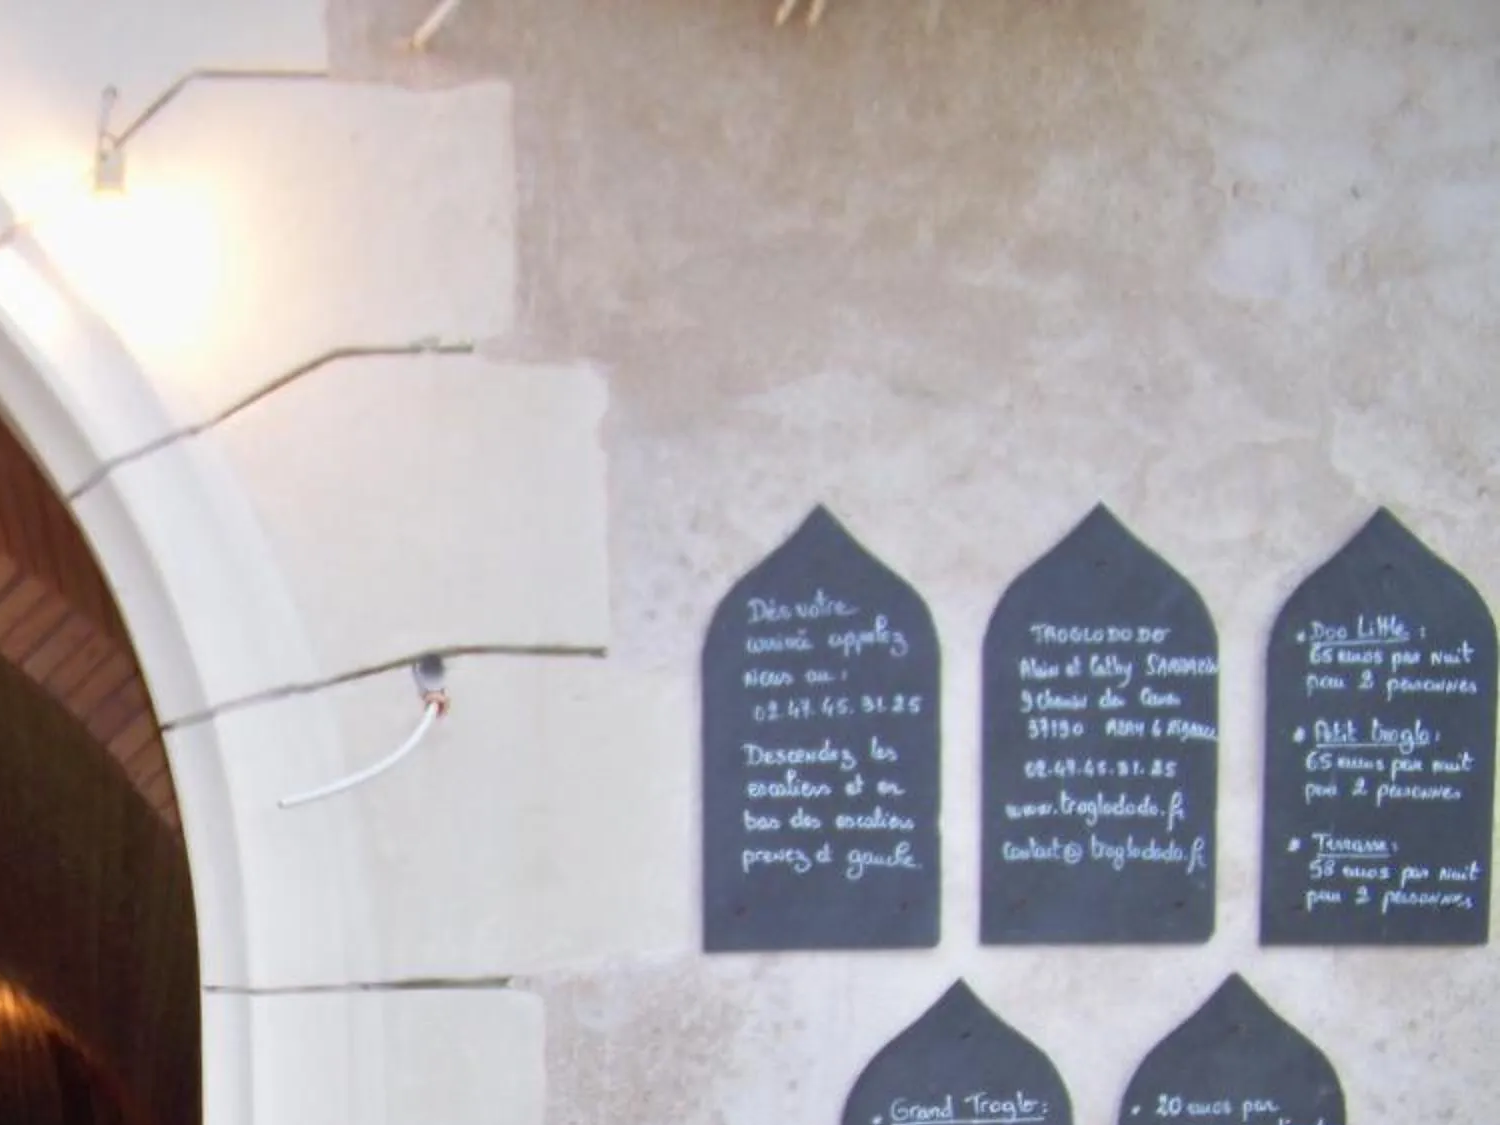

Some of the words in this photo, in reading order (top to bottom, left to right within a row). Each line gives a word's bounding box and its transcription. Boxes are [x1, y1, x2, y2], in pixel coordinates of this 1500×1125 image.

[795, 589, 858, 619] votre
[1019, 658, 1059, 680] Alain
[1065, 657, 1081, 677] et
[1089, 654, 1133, 688] Cathy
[1338, 652, 1383, 664] euros
[1391, 652, 1421, 672] par
[1360, 670, 1375, 689] 2
[1386, 678, 1477, 701] personnes
[1020, 690, 1032, 713] 9
[1027, 718, 1084, 739] 37190
[1315, 718, 1357, 744] Petit
[741, 737, 857, 771] Descendez
[871, 736, 898, 761] les
[1305, 753, 1332, 772] 65
[1338, 757, 1384, 771] euros
[1391, 758, 1423, 780] par
[748, 769, 831, 798] escaliers
[845, 774, 864, 796] et
[877, 780, 905, 795] en
[1352, 778, 1368, 796] 2
[744, 810, 780, 831] bas
[789, 807, 821, 829] des
[835, 805, 914, 830] escaliers
[742, 849, 812, 874] prenez
[1309, 859, 1334, 880] 58
[1343, 865, 1390, 880] euros
[1401, 866, 1429, 887] par
[1356, 886, 1370, 903] 2
[890, 1095, 953, 1121] Grand
[1156, 1093, 1181, 1117] 20
[1187, 1102, 1231, 1115] euros
[1242, 1100, 1280, 1122] par
